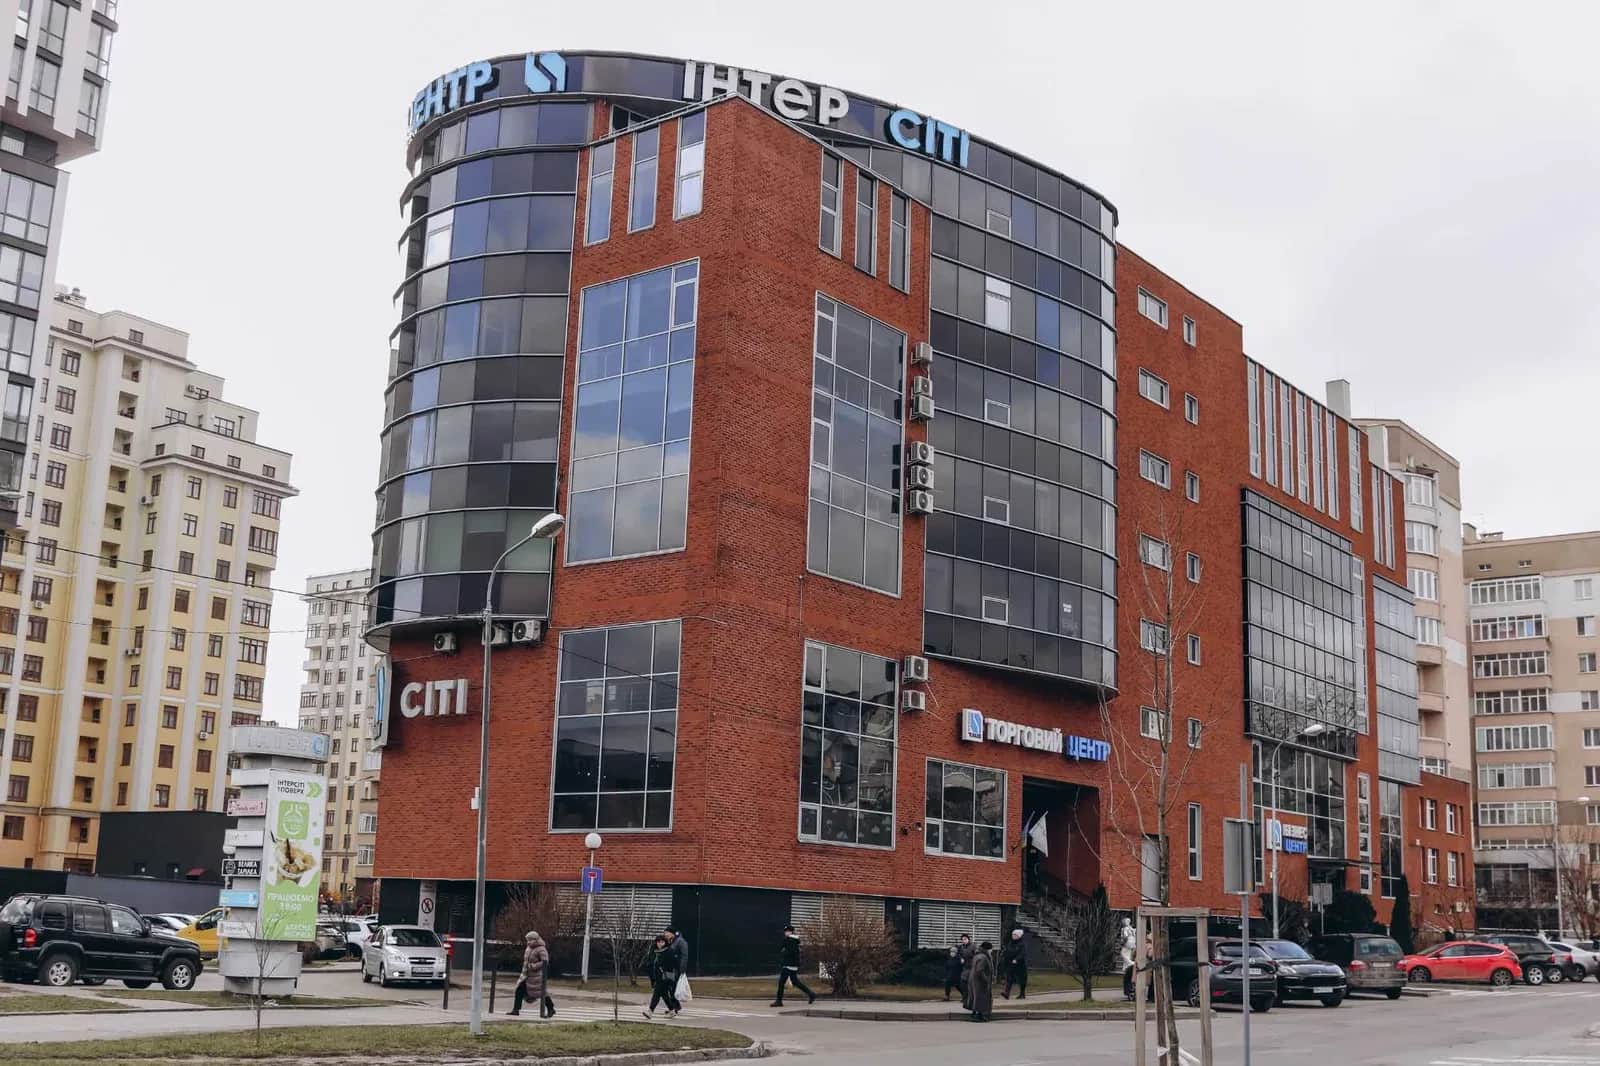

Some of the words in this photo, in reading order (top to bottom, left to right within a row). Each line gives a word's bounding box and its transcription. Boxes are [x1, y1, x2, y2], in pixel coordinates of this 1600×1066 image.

[408, 58, 492, 131] ЕНТР
[985, 717, 1063, 754] ТОРГОВИЙ
[1067, 735, 1111, 762] ЦЕНТР
[281, 786, 304, 794] ПОВЕРХ
